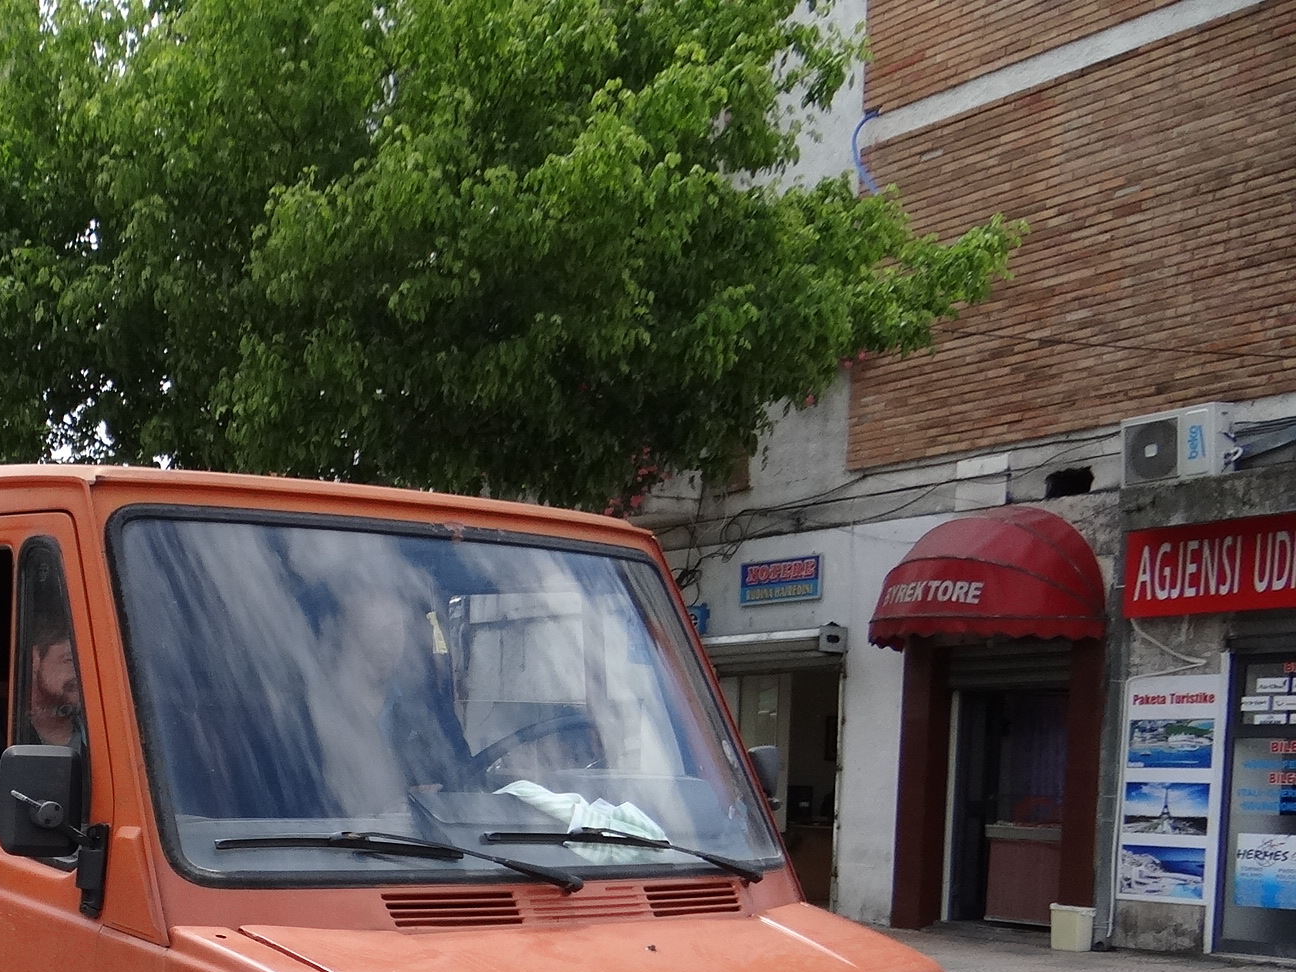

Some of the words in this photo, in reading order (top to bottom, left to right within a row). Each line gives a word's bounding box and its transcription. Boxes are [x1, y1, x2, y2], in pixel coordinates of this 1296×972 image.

[1132, 535, 1242, 601] AGJENSI
[1254, 530, 1296, 593] UD
[1132, 694, 1167, 706] Paketa
[1169, 692, 1216, 705] Turistike
[1236, 849, 1290, 862] HERMES
